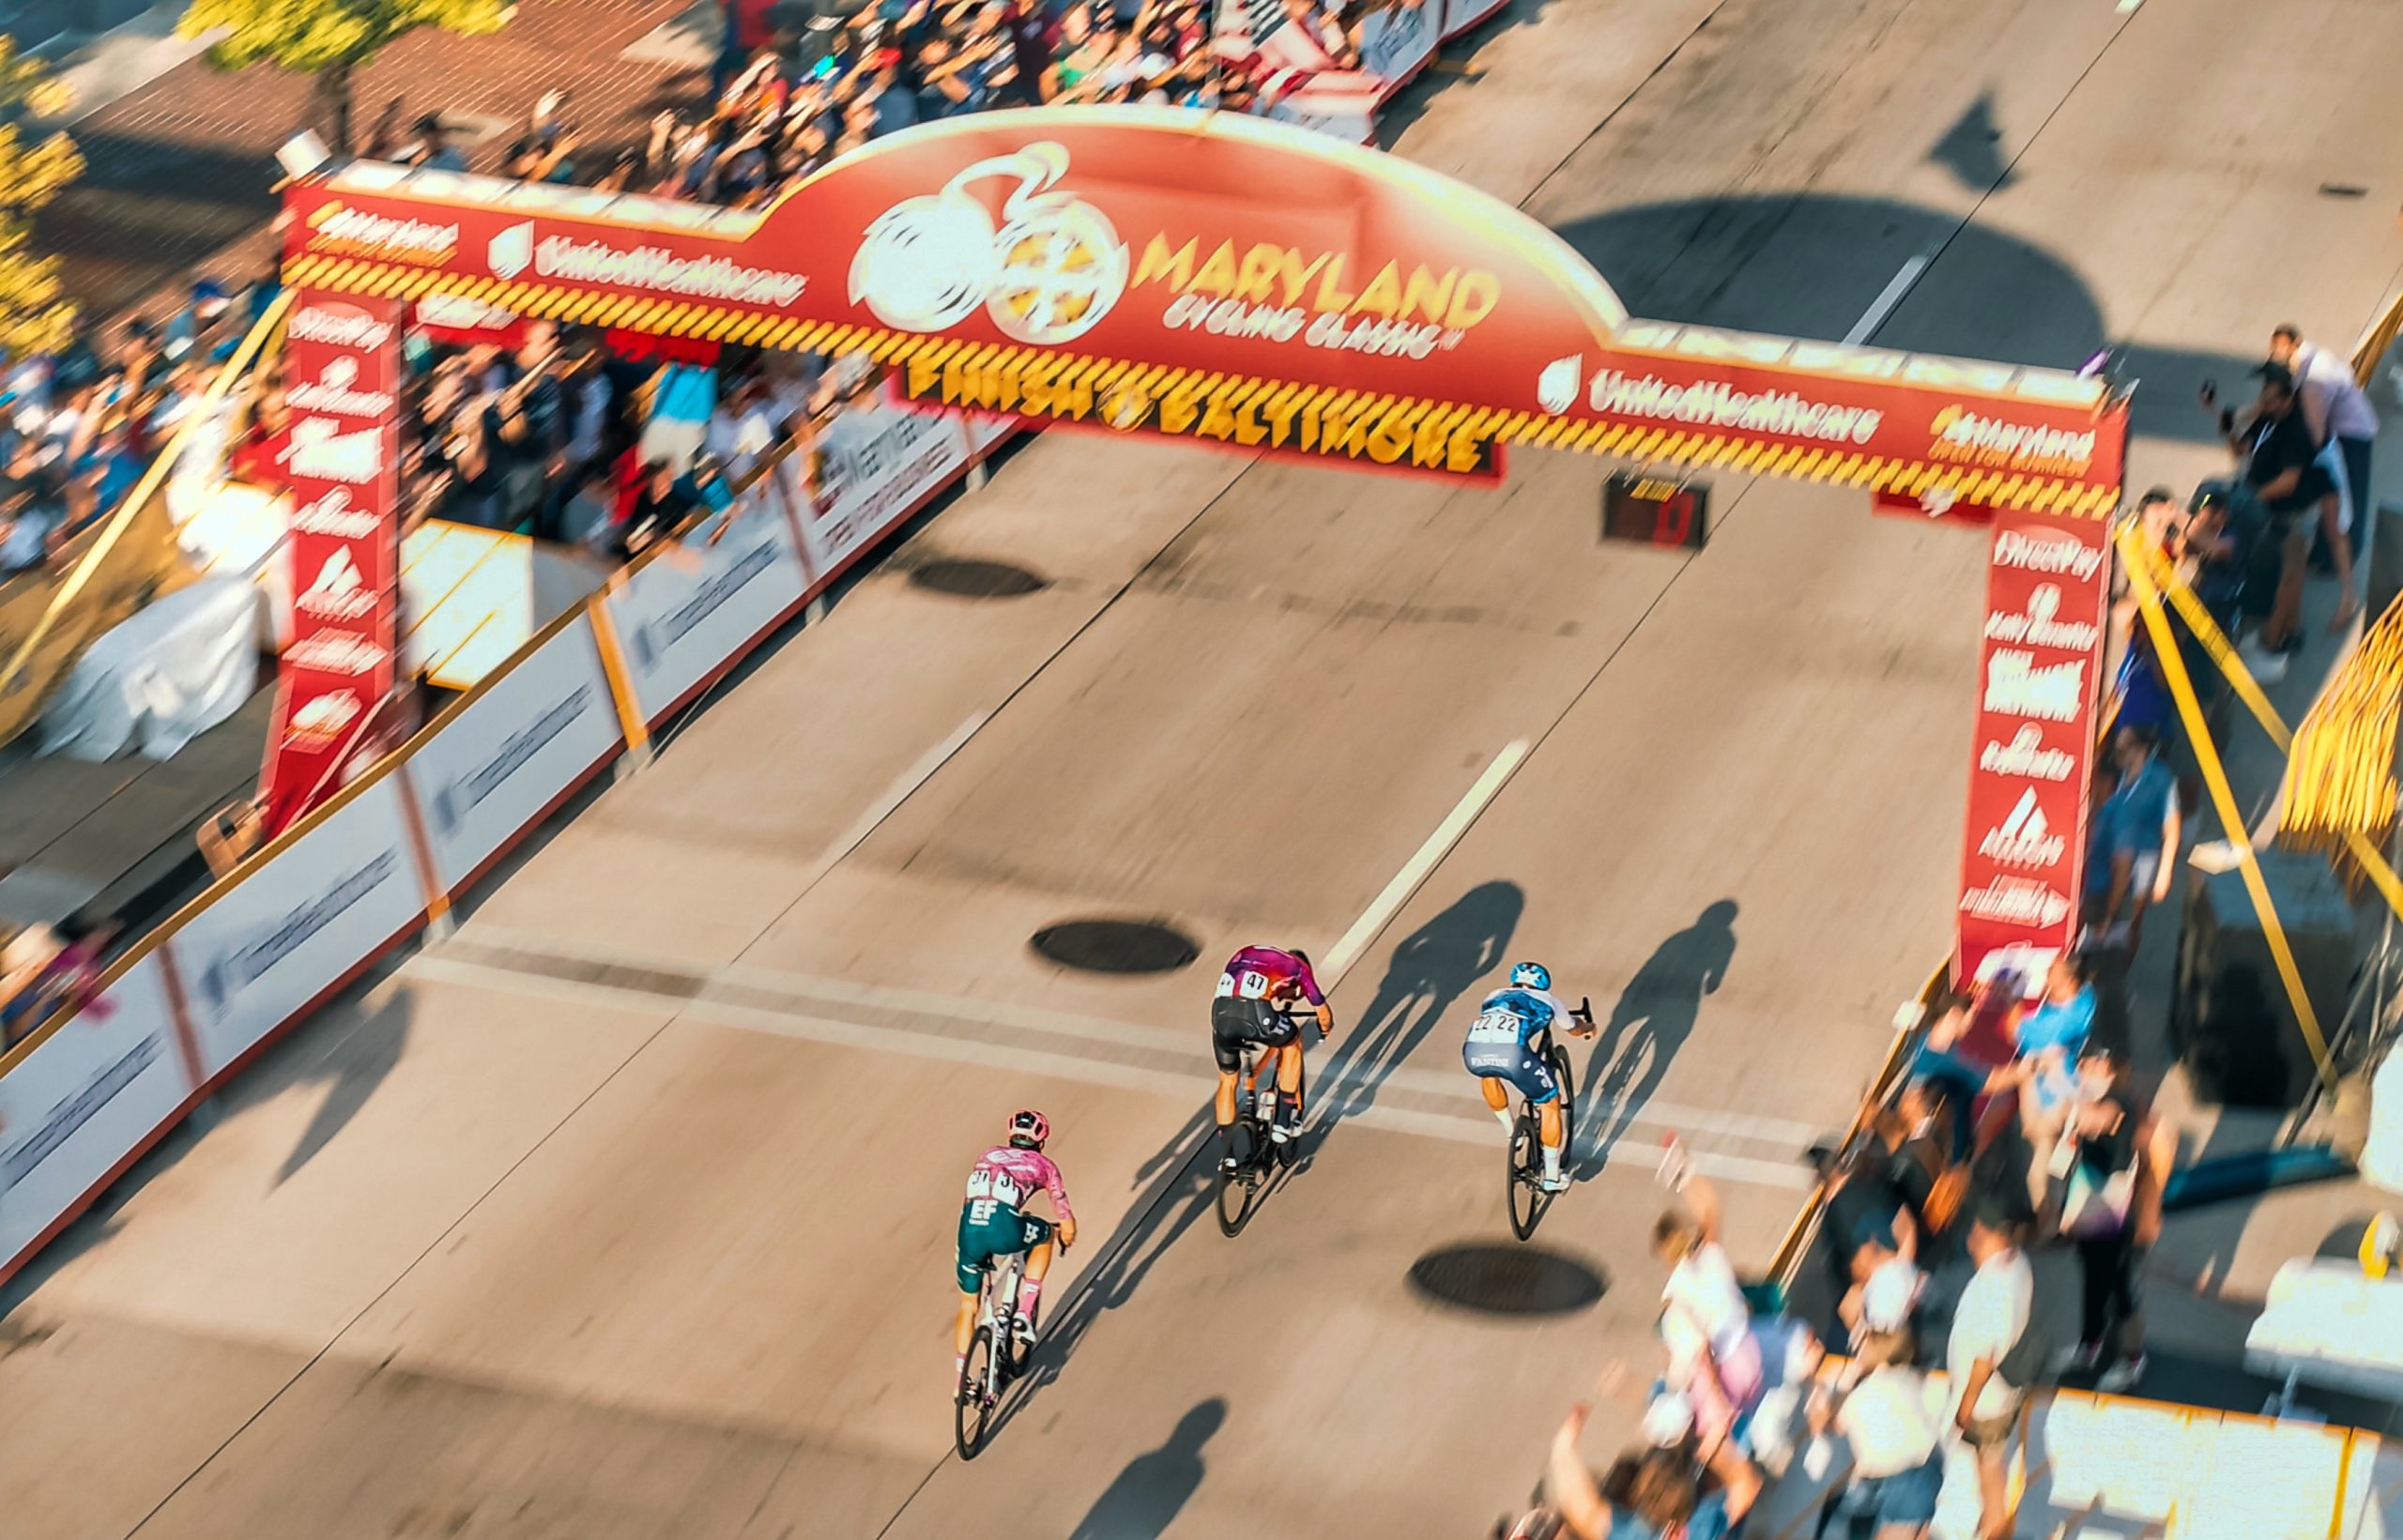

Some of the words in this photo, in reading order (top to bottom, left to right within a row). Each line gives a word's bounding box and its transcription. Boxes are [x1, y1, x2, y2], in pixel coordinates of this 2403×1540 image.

[534, 235, 810, 308] UnitedHealthcare
[1129, 230, 1502, 328] MARYLAND
[1162, 293, 1308, 343] CYCLING
[1304, 311, 1443, 361] CLASSIC
[1588, 367, 1885, 446] UnitedHealthcare
[1247, 973, 1264, 991] 47
[1497, 1015, 1516, 1032] 22
[970, 1199, 999, 1220] EF
